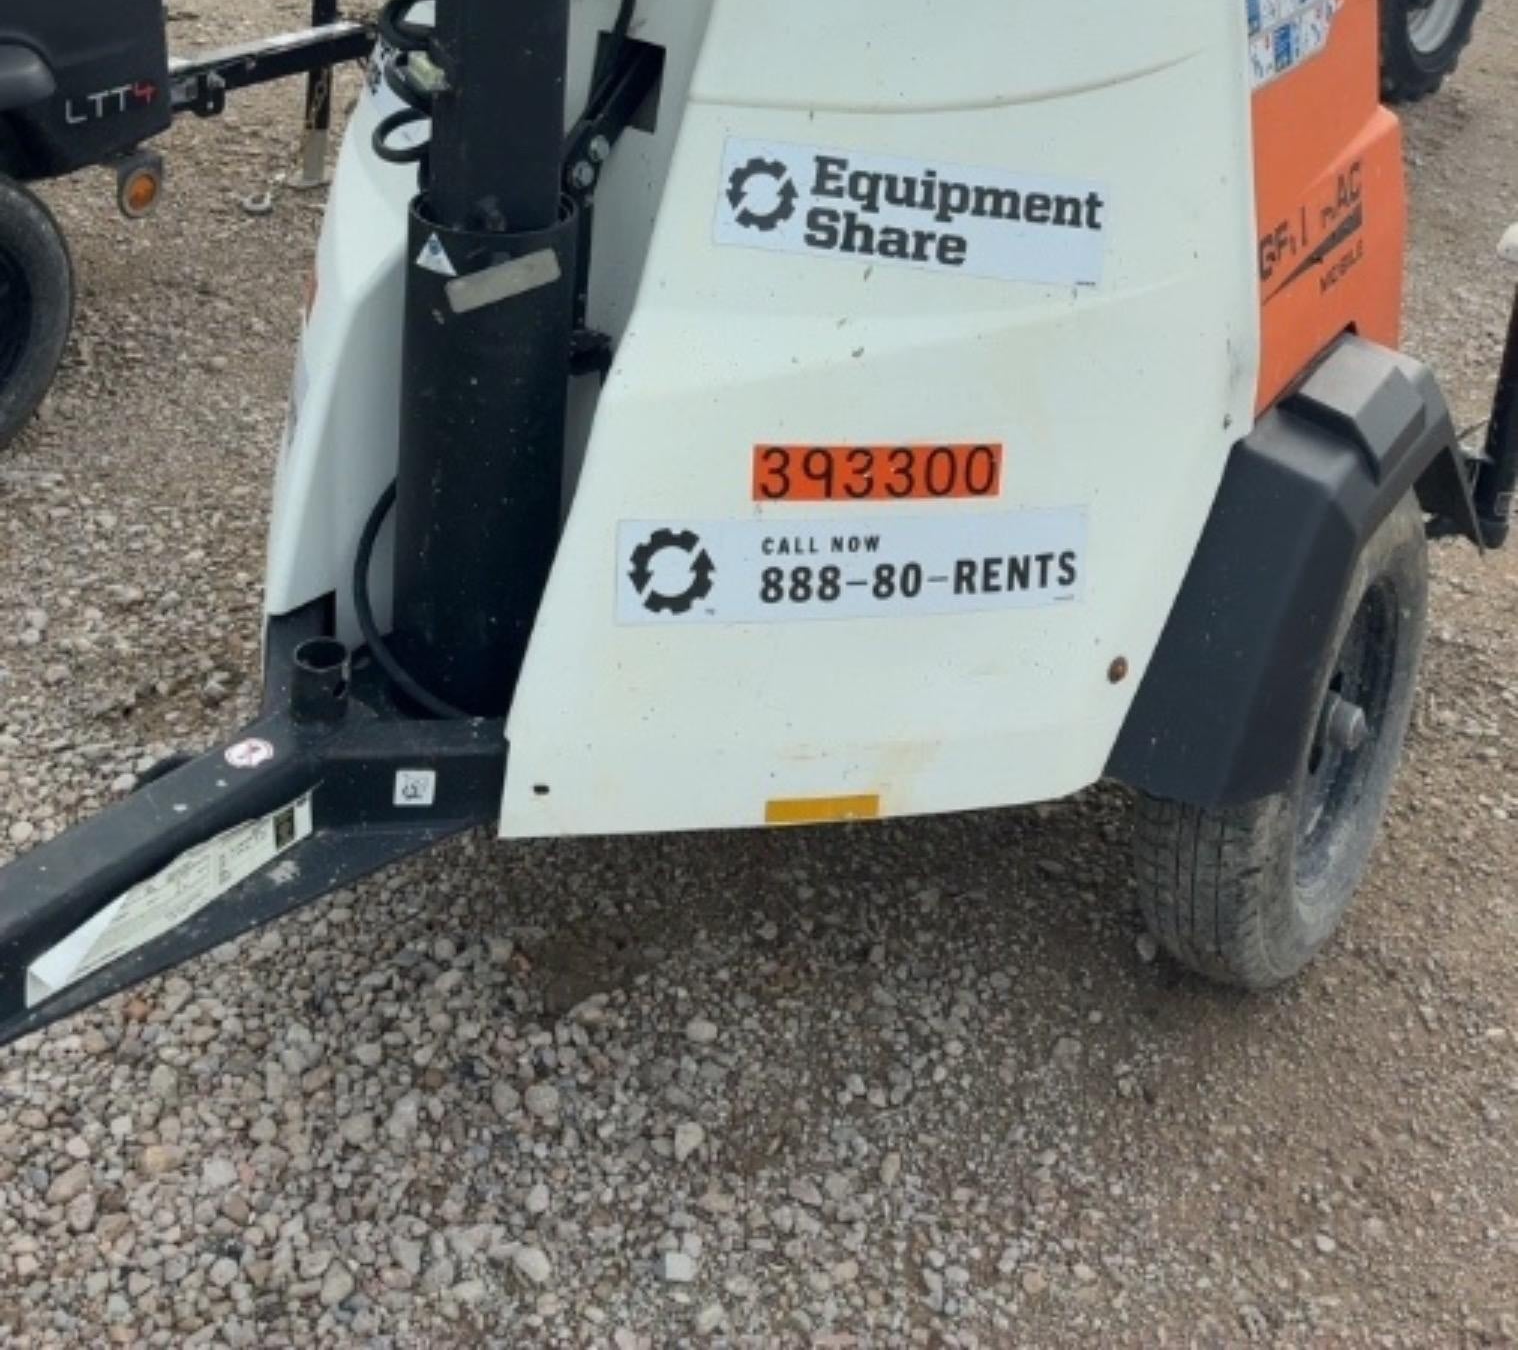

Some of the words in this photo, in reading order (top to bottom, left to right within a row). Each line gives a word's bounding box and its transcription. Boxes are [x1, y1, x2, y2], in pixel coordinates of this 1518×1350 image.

[65, 82, 155, 125] LTT4
[810, 155, 1104, 230] Equipment
[803, 206, 968, 266] Share
[760, 446, 998, 499] 393300
[761, 536, 819, 556] CALL
[830, 534, 881, 553] NOW
[759, 549, 1077, 604] 888-80-RENTS
